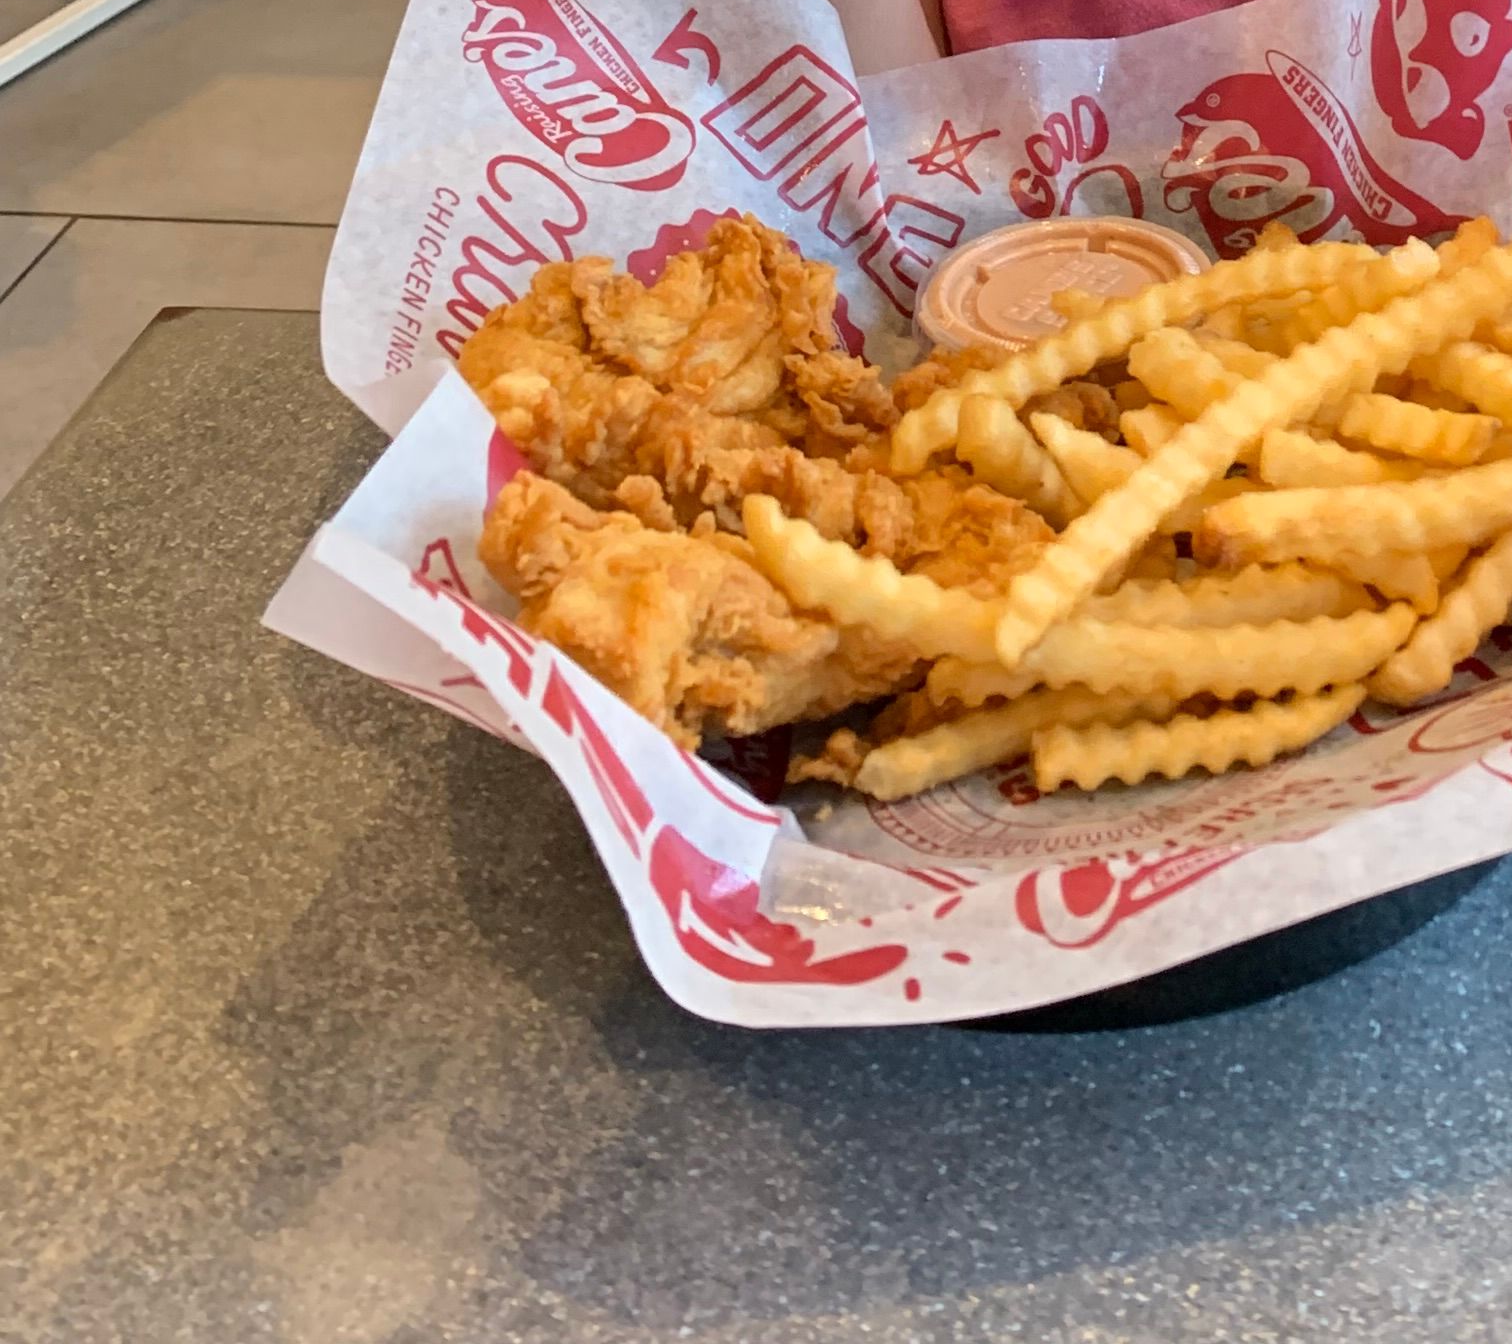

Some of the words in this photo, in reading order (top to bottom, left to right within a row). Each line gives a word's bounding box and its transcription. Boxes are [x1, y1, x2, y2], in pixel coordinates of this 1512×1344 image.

[462, 0, 694, 184] Cane's
[587, 35, 641, 96] CHICKEN
[1282, 64, 1345, 148] FINGERS
[500, 74, 573, 144] Raising
[1341, 140, 1393, 222] CHICKEN
[401, 186, 461, 311] CHICKEN
